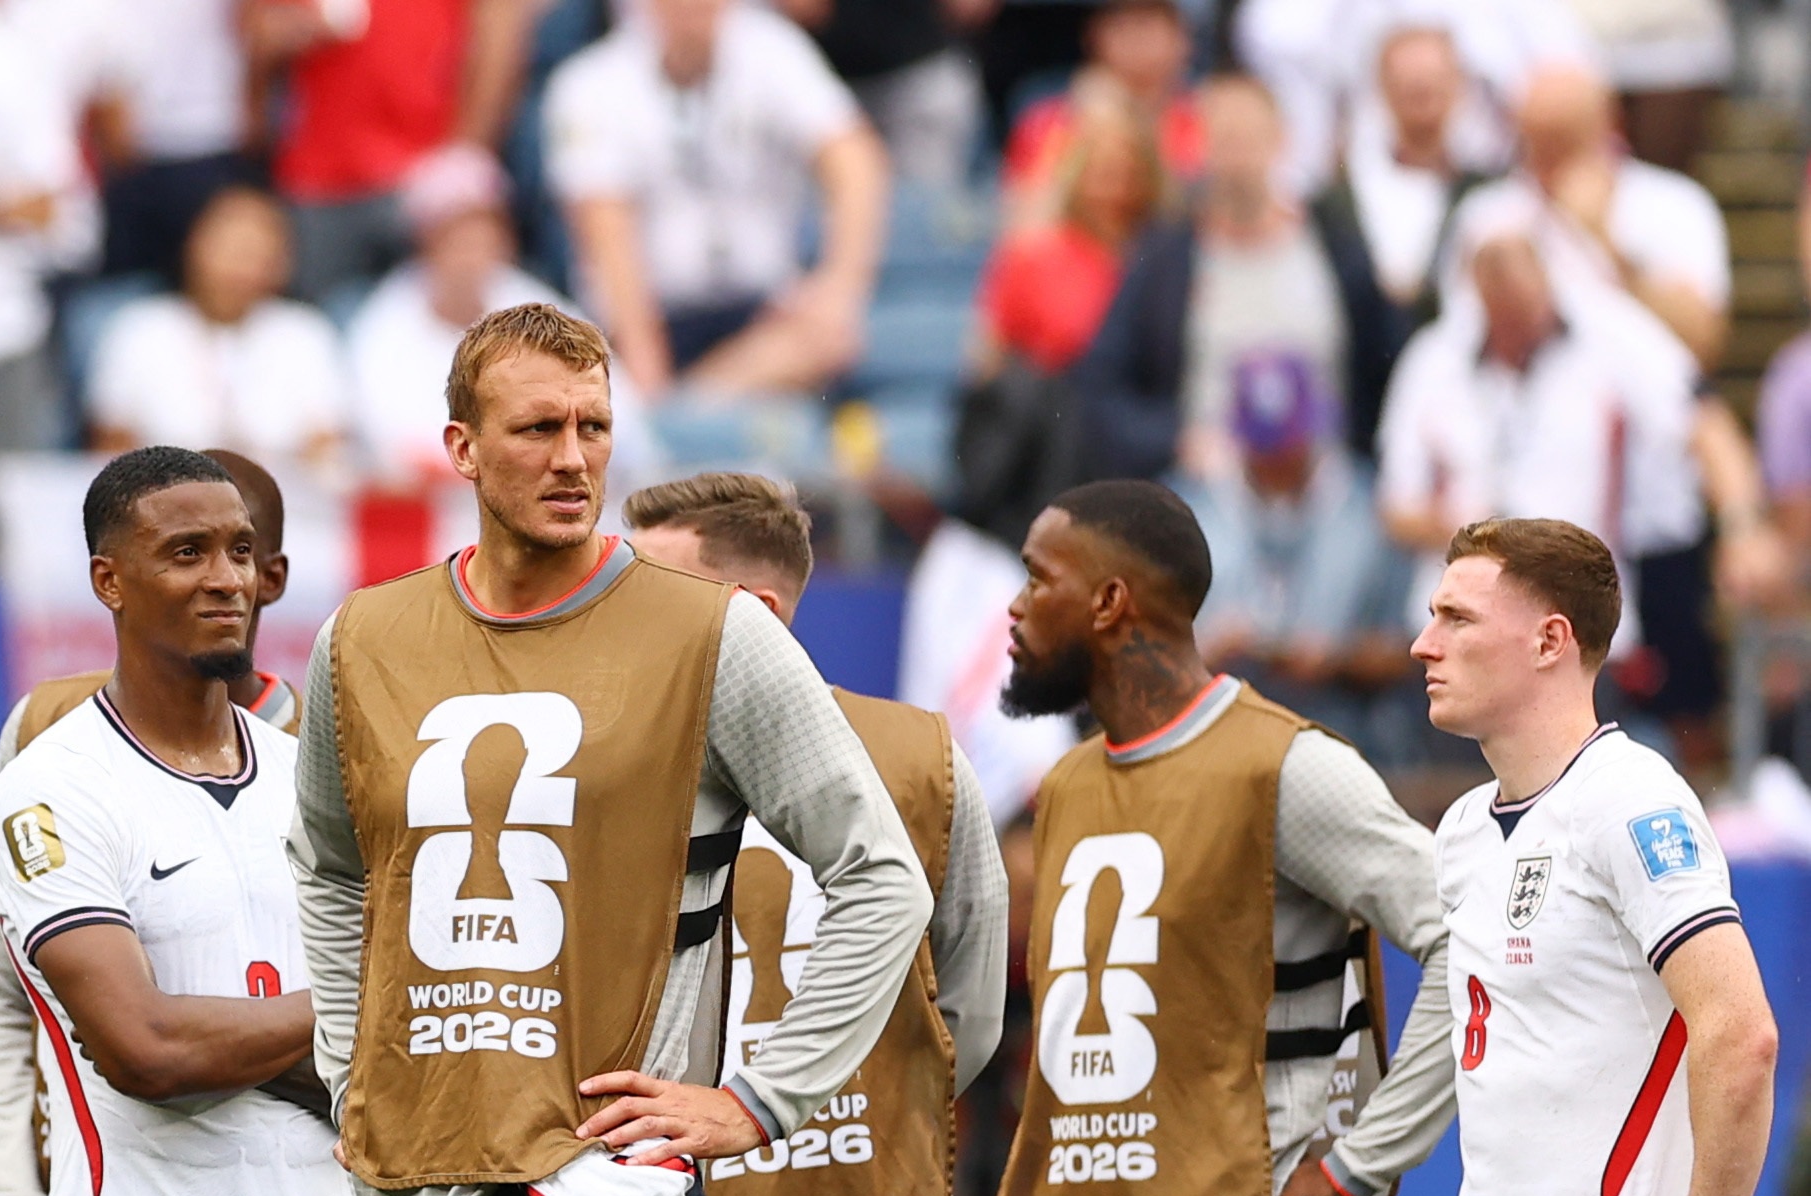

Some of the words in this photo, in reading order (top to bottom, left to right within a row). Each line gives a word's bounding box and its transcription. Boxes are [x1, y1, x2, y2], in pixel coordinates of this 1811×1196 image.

[451, 913, 519, 945] FIFA
[407, 980, 495, 1010] WORLD
[498, 983, 563, 1013] CUP
[409, 1011, 557, 1058] 2026
[1459, 973, 1492, 1071] 8
[1070, 1050, 1115, 1078] FIFA
[1049, 1113, 1104, 1141] WORLD
[1105, 1112, 1158, 1138] CUP
[1047, 1140, 1158, 1185] 2026
